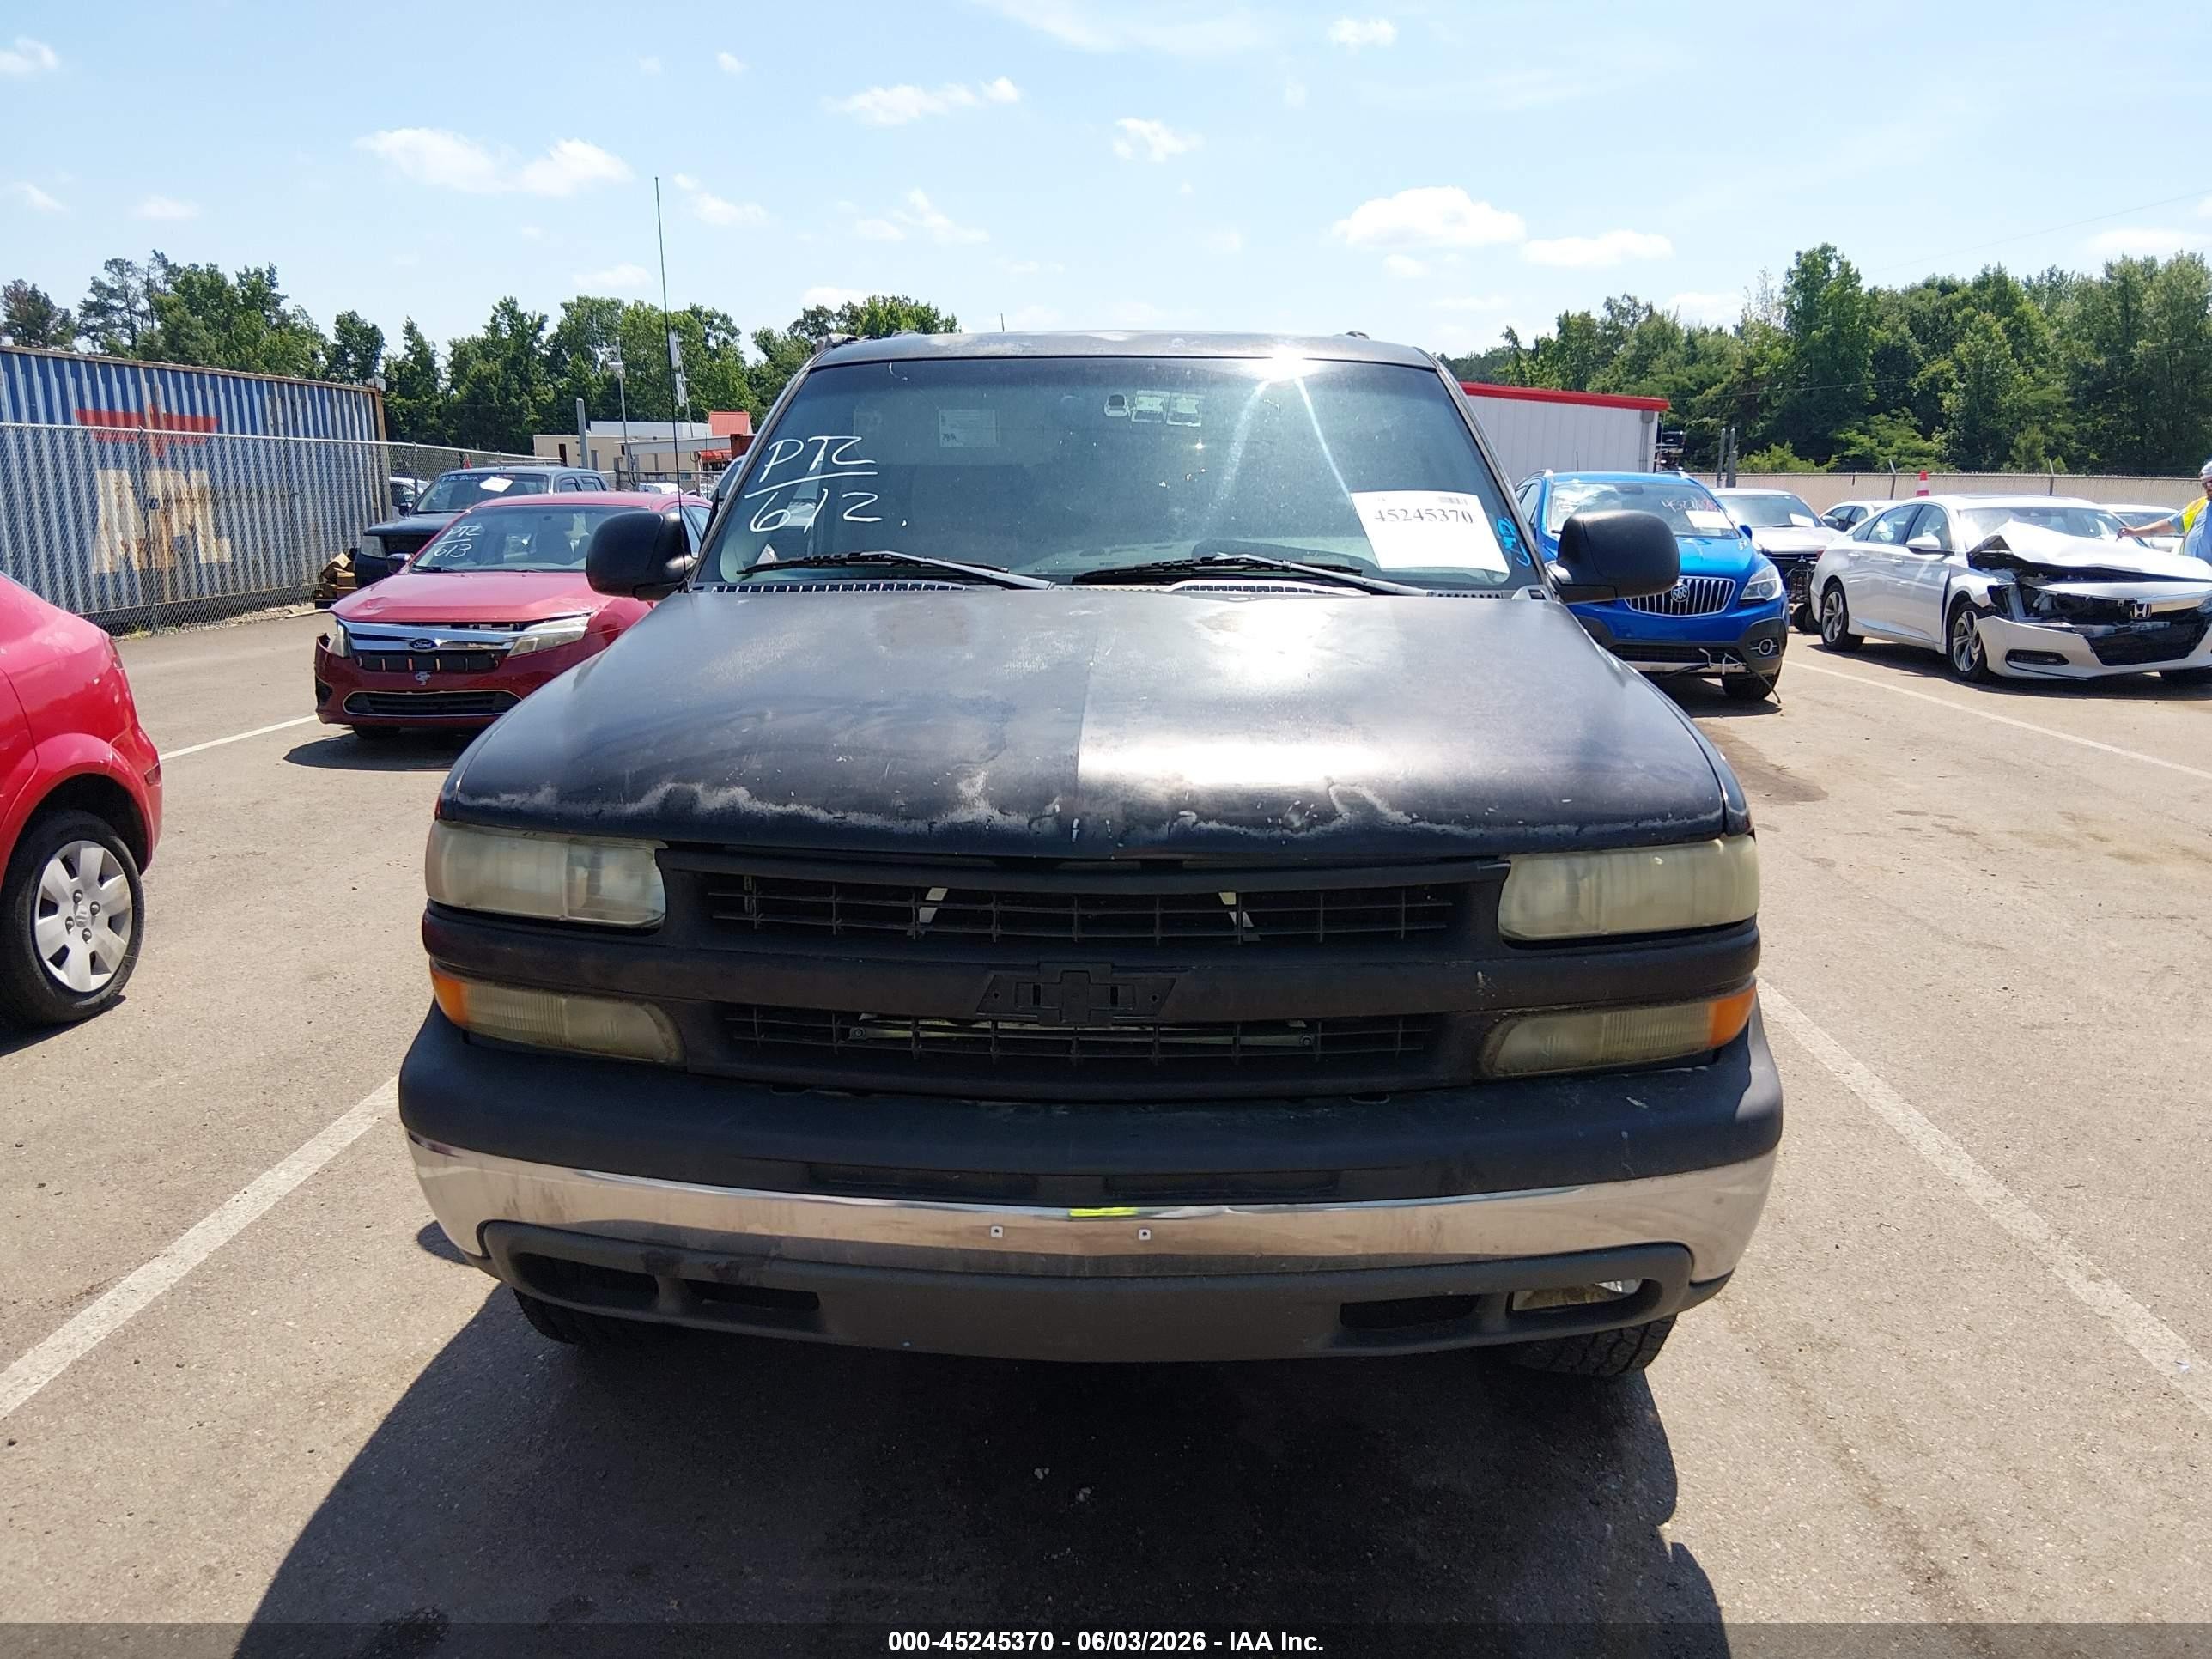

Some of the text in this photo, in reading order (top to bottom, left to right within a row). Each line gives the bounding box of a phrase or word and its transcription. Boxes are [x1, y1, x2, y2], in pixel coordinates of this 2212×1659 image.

[92, 469, 232, 574] APL
[749, 488, 883, 534] 612
[1374, 507, 1474, 524] 45245370
[434, 544, 473, 558] 613
